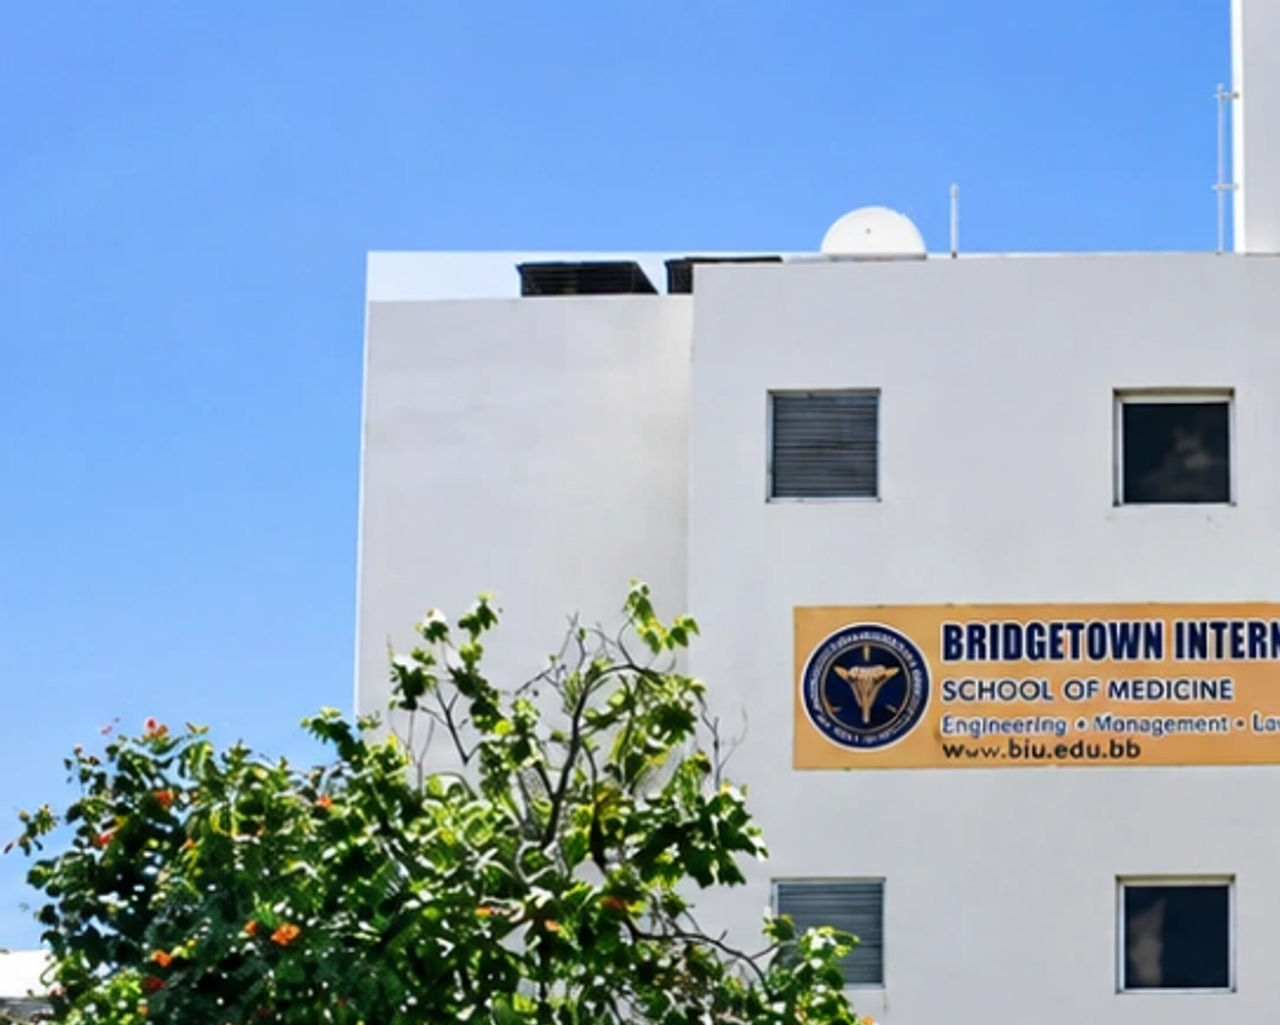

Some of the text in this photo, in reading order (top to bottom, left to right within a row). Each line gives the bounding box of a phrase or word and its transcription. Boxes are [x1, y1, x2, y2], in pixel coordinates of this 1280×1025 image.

[942, 621, 1164, 662] BRIDGETOWN
[942, 679, 1233, 702] SCHOOL OF MEDICINE
[942, 715, 1067, 738] Engineering
[1094, 714, 1228, 735] Management
